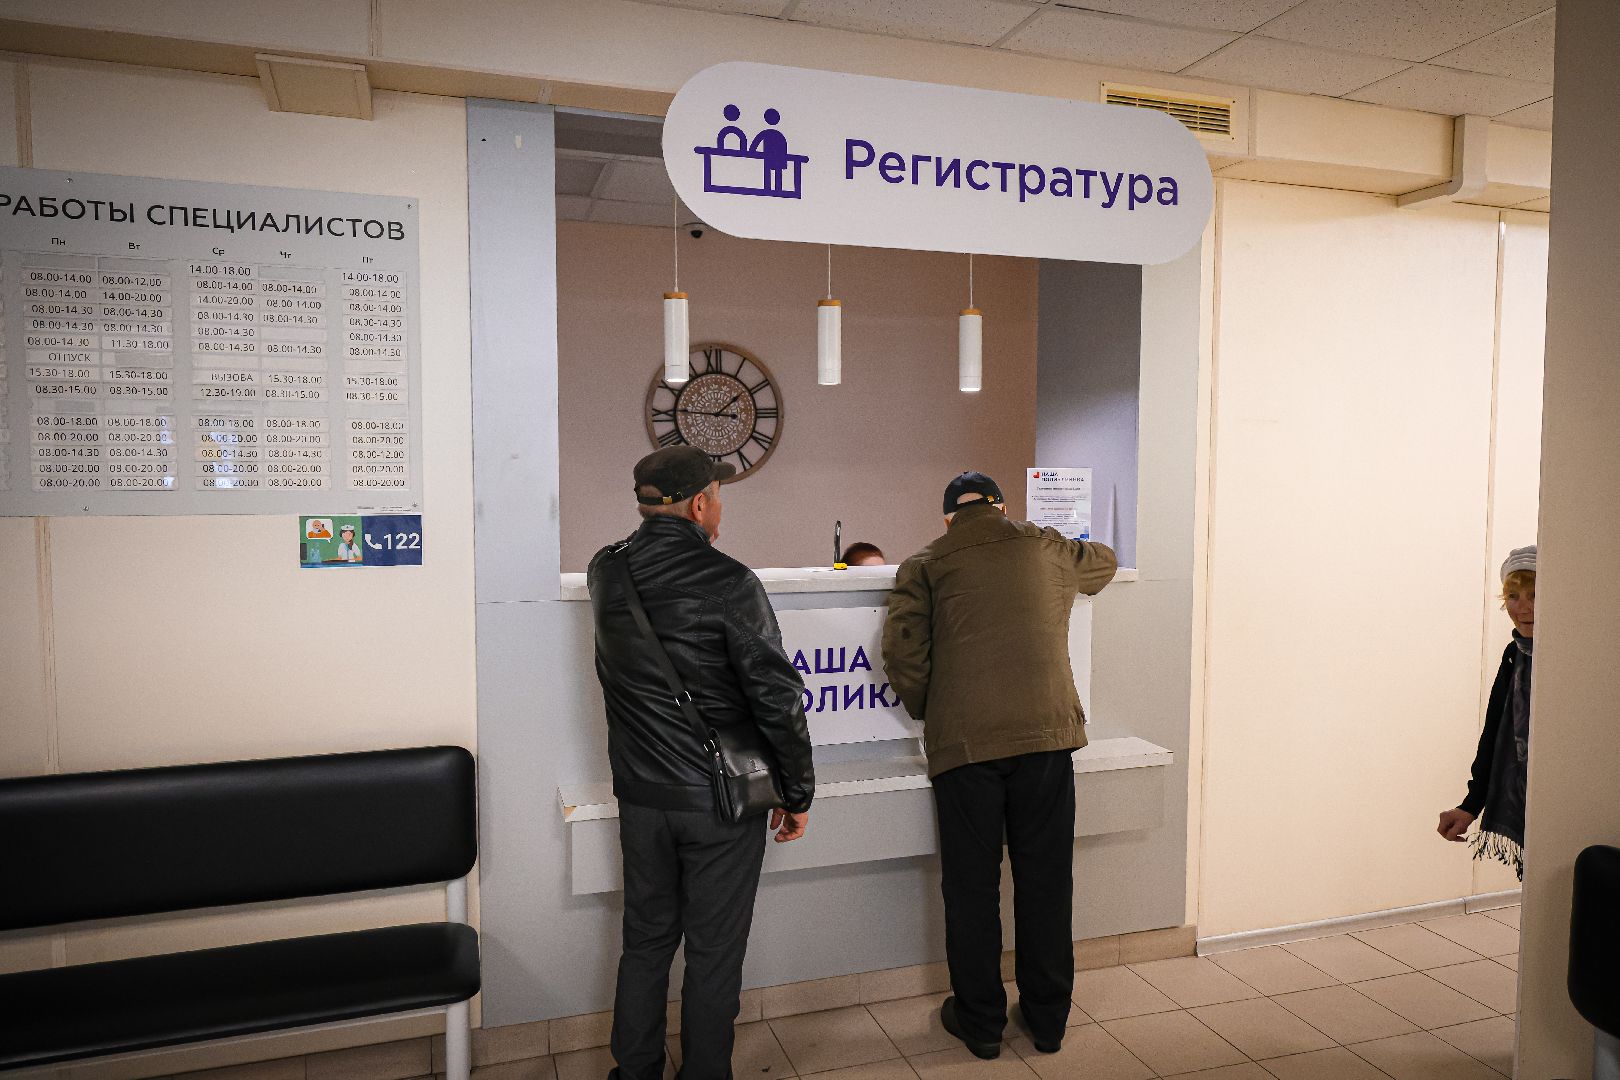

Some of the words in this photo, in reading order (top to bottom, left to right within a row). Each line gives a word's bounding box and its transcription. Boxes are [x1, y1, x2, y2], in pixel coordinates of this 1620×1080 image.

[845, 138, 1179, 210] Регистратура
[146, 204, 405, 240] СПЕЦИАЛИСТОВ
[51, 237, 66, 246] Пн
[212, 247, 225, 256] Ср
[280, 251, 292, 259] Чт
[362, 256, 373, 264] Пт
[30, 272, 92, 283] 08.00-14.00
[102, 276, 162, 287] 08.00-12.00
[196, 281, 253, 291] 08.00-14.00
[262, 284, 317, 294] 08.00-14.00
[190, 265, 251, 276] 14.00-18.00
[342, 272, 399, 284] 14.00-18.00
[25, 288, 87, 299] 08.00-14.00
[103, 292, 162, 303] 14.00-20.00
[198, 296, 254, 306] 14.00-20.00
[350, 303, 402, 313] 08.00-14.00
[32, 305, 93, 315] 08.00-14.30
[103, 308, 163, 318] 08.00-14.30
[197, 312, 254, 322] 08.00-14.30
[32, 320, 94, 331] 08.00-14.30
[104, 323, 163, 333] 08.00-14.30
[198, 327, 255, 337] 08.00-14.30
[28, 337, 89, 347] 08.00-14.30
[111, 339, 169, 349] 11.30-18.00
[198, 342, 255, 352] 08.00-14.30
[267, 344, 322, 354] 08.00-14.30
[48, 353, 92, 363] ОТПУСК
[30, 369, 90, 378] 15.30-18.00
[35, 386, 96, 395] 08.30-15.00
[109, 387, 168, 395] 08.30-15.00
[37, 417, 98, 426] 08.00-18.00
[107, 418, 167, 427] 08.00-18.00
[198, 419, 254, 428] 08.00-18.00
[266, 420, 321, 429] 08.00-18.00
[37, 433, 99, 442] 08.00-20.00
[109, 433, 167, 442] 08.00-20.00
[39, 449, 99, 457] 08.00-14.30
[109, 449, 168, 457] 08.00-14.30
[39, 464, 100, 473] 08.00-20.00
[109, 464, 168, 473] 08.00-20.00
[268, 465, 322, 473] 08.00-20.00
[40, 479, 100, 487] 08.00-20.00
[110, 478, 168, 487] 08.00-20.00
[268, 478, 322, 487] 08.00-20.00
[384, 533, 420, 549] 122
[791, 646, 872, 674] АША
